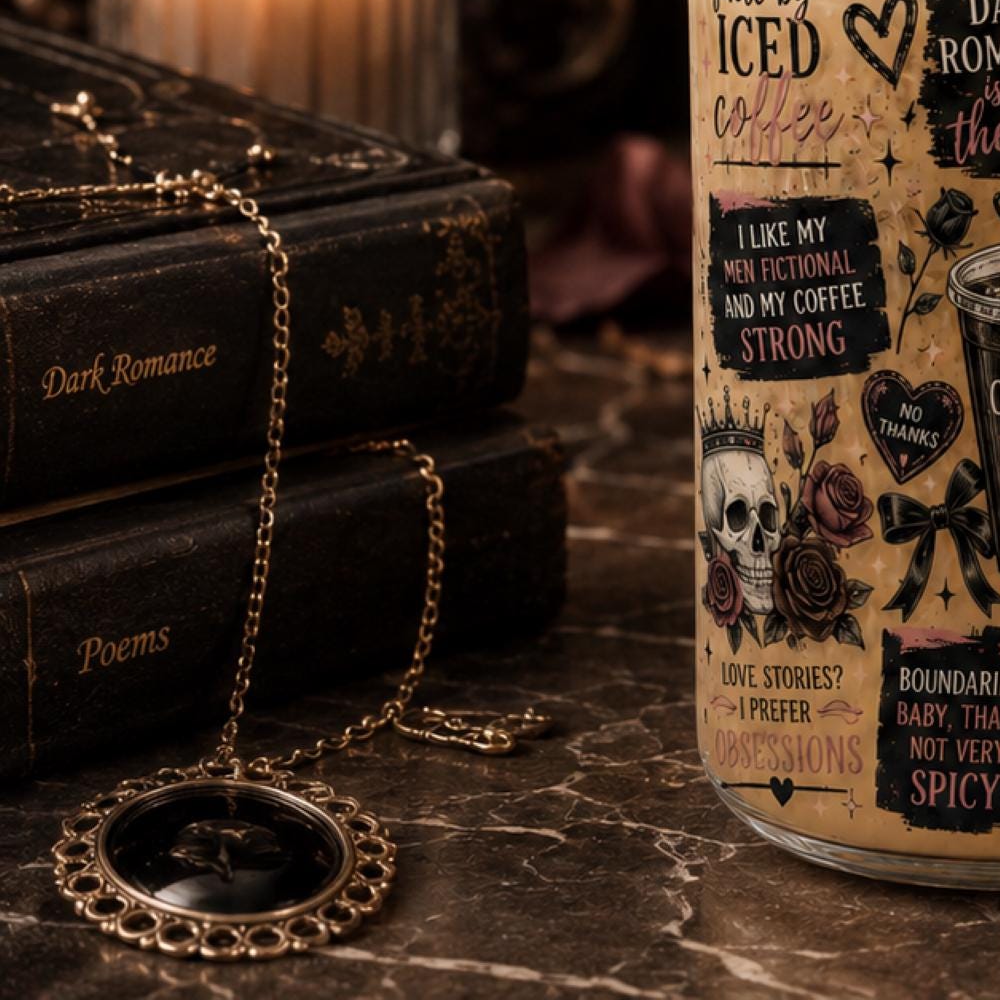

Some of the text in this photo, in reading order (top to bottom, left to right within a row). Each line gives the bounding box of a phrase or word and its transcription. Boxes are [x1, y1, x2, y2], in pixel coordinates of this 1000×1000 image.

[717, 14, 821, 79] ICED
[713, 71, 845, 166] coffee
[738, 216, 827, 250] I LIKE MY
[724, 249, 857, 285] MEN FICTIONAL
[724, 281, 867, 319] AND MY COFFEE
[740, 319, 847, 364] STRONG
[41, 344, 218, 401] Dark Romance
[899, 402, 923, 423] NO
[879, 417, 940, 450] THANKS
[76, 625, 171, 675] Poems
[721, 661, 844, 690] LOVE STORIES?
[739, 696, 812, 723] I PREFER
[896, 701, 953, 732] BABY,
[714, 728, 864, 775] OBSESSIONS
[909, 736, 949, 761] NOT
[911, 768, 1000, 810] SPICY
